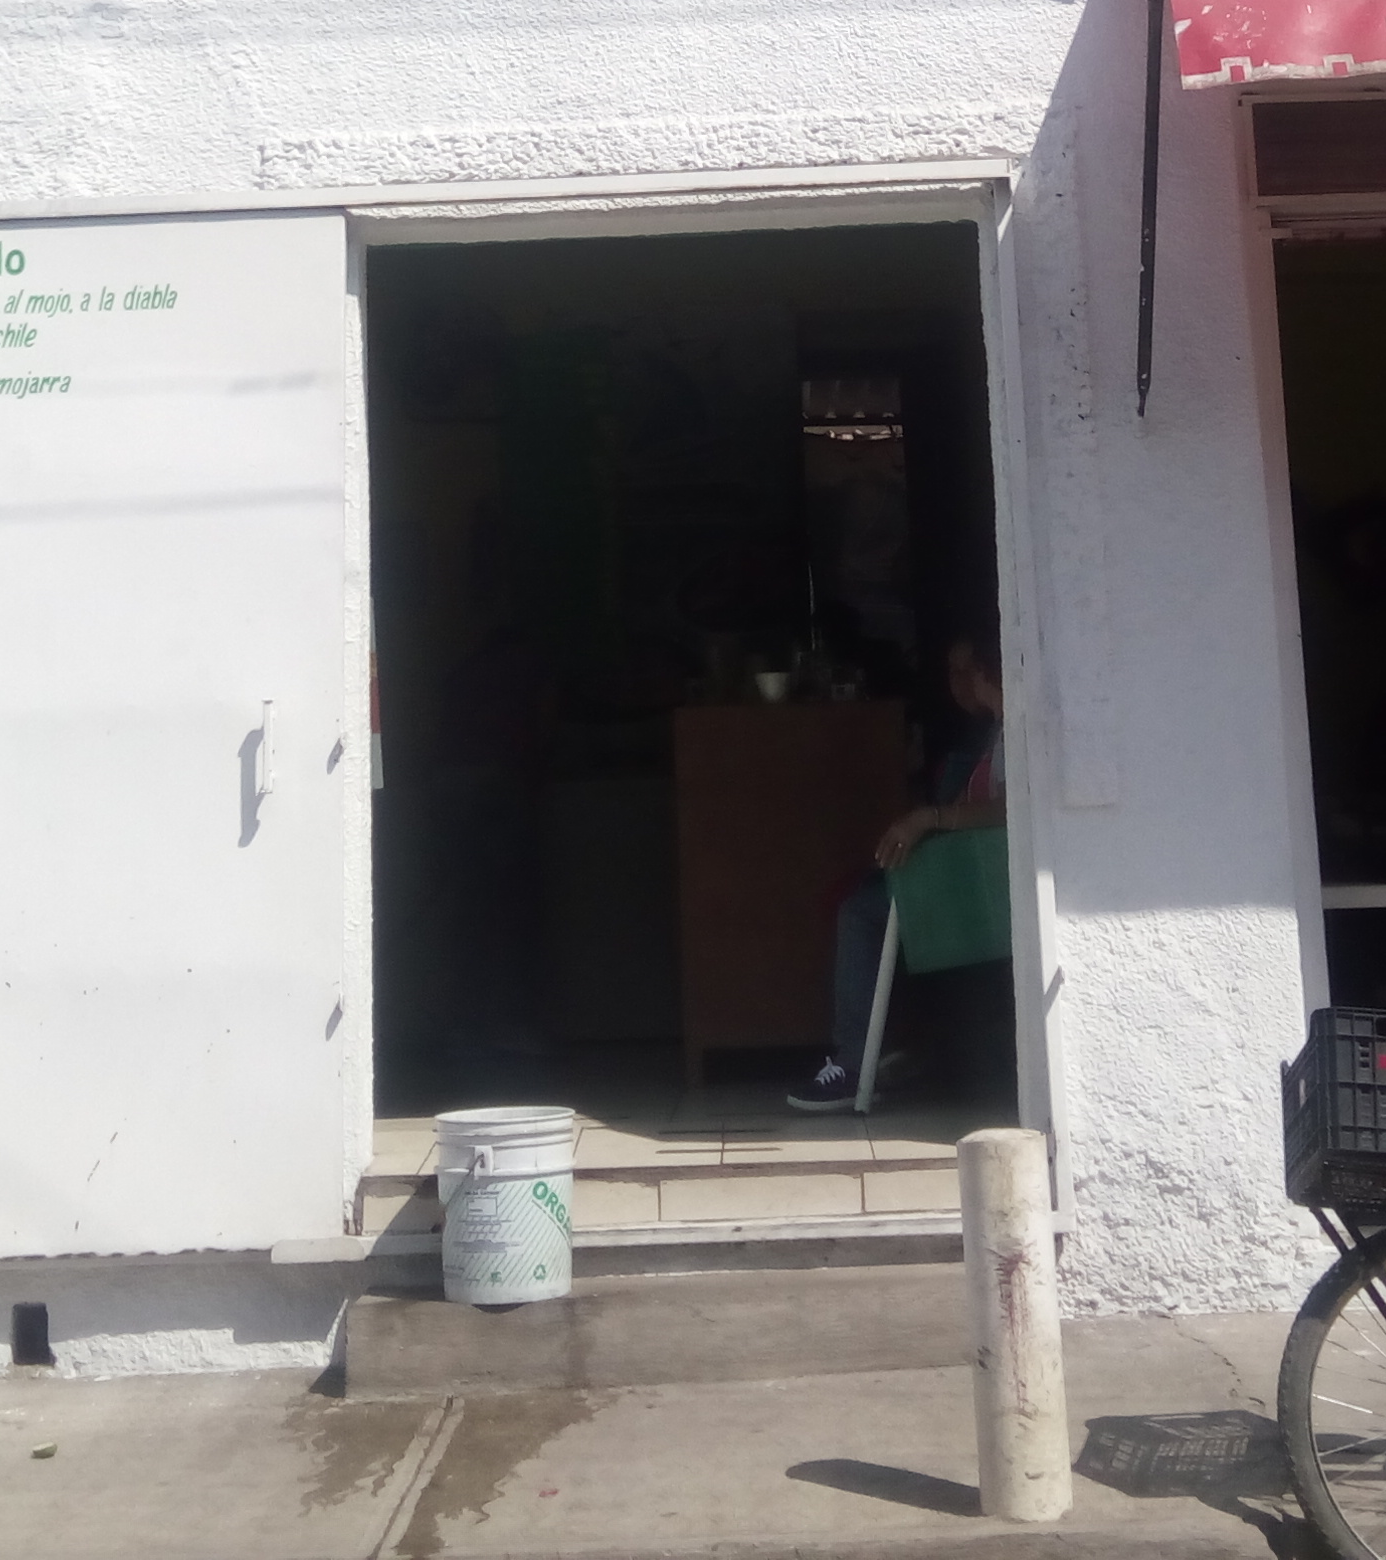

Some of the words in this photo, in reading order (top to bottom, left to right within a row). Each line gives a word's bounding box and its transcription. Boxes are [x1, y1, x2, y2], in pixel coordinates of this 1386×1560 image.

[4, 288, 25, 315] al
[79, 291, 91, 312] a
[98, 286, 115, 312] la
[122, 283, 178, 311] diabla
